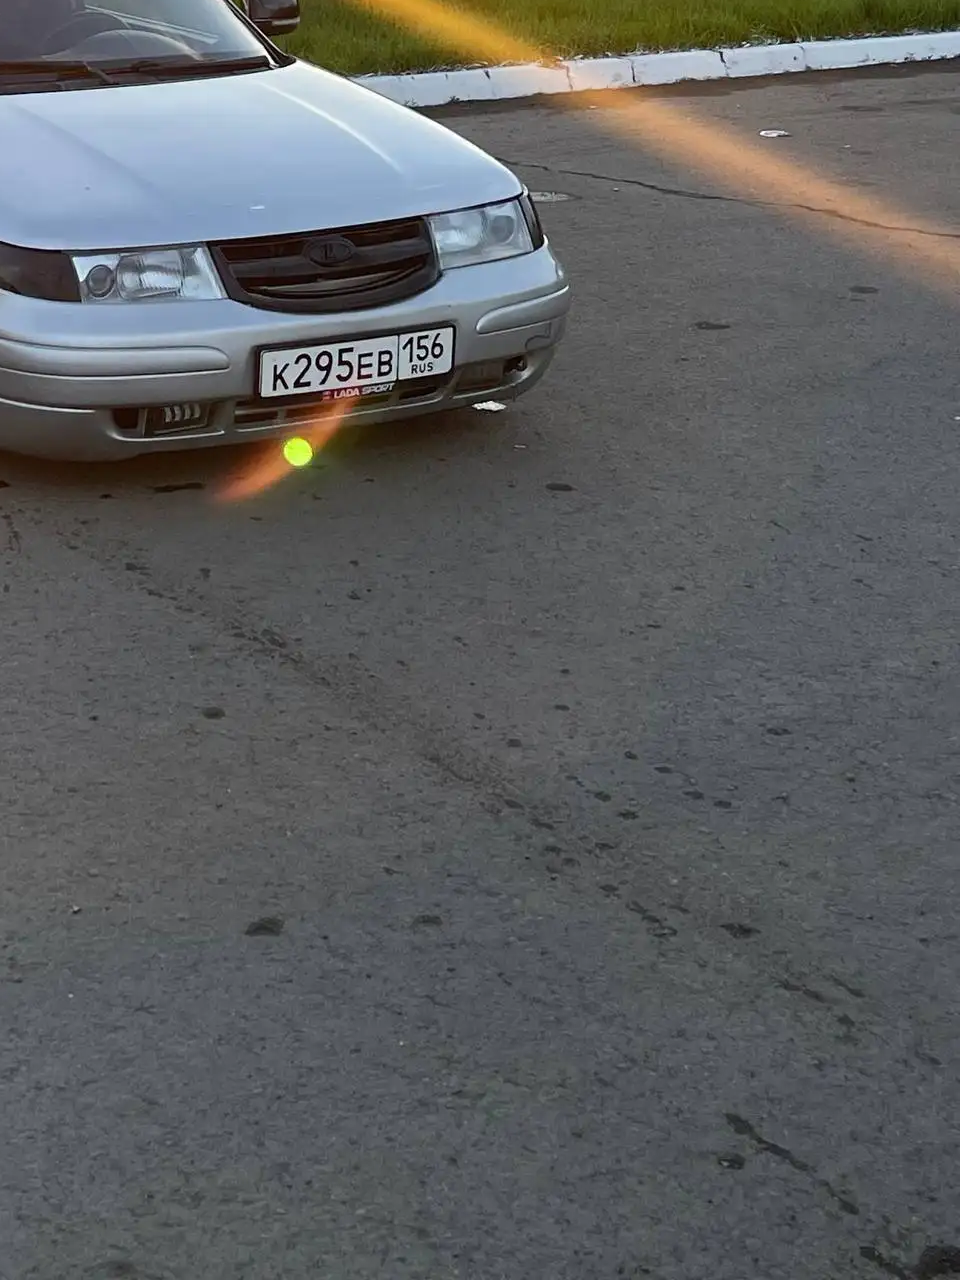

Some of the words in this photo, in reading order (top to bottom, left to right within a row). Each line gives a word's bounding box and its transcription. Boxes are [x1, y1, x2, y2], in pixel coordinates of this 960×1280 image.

[402, 333, 444, 363] 156
[411, 362, 434, 374] RUS
[333, 388, 360, 399] LADA
[361, 382, 396, 395] SPORT
